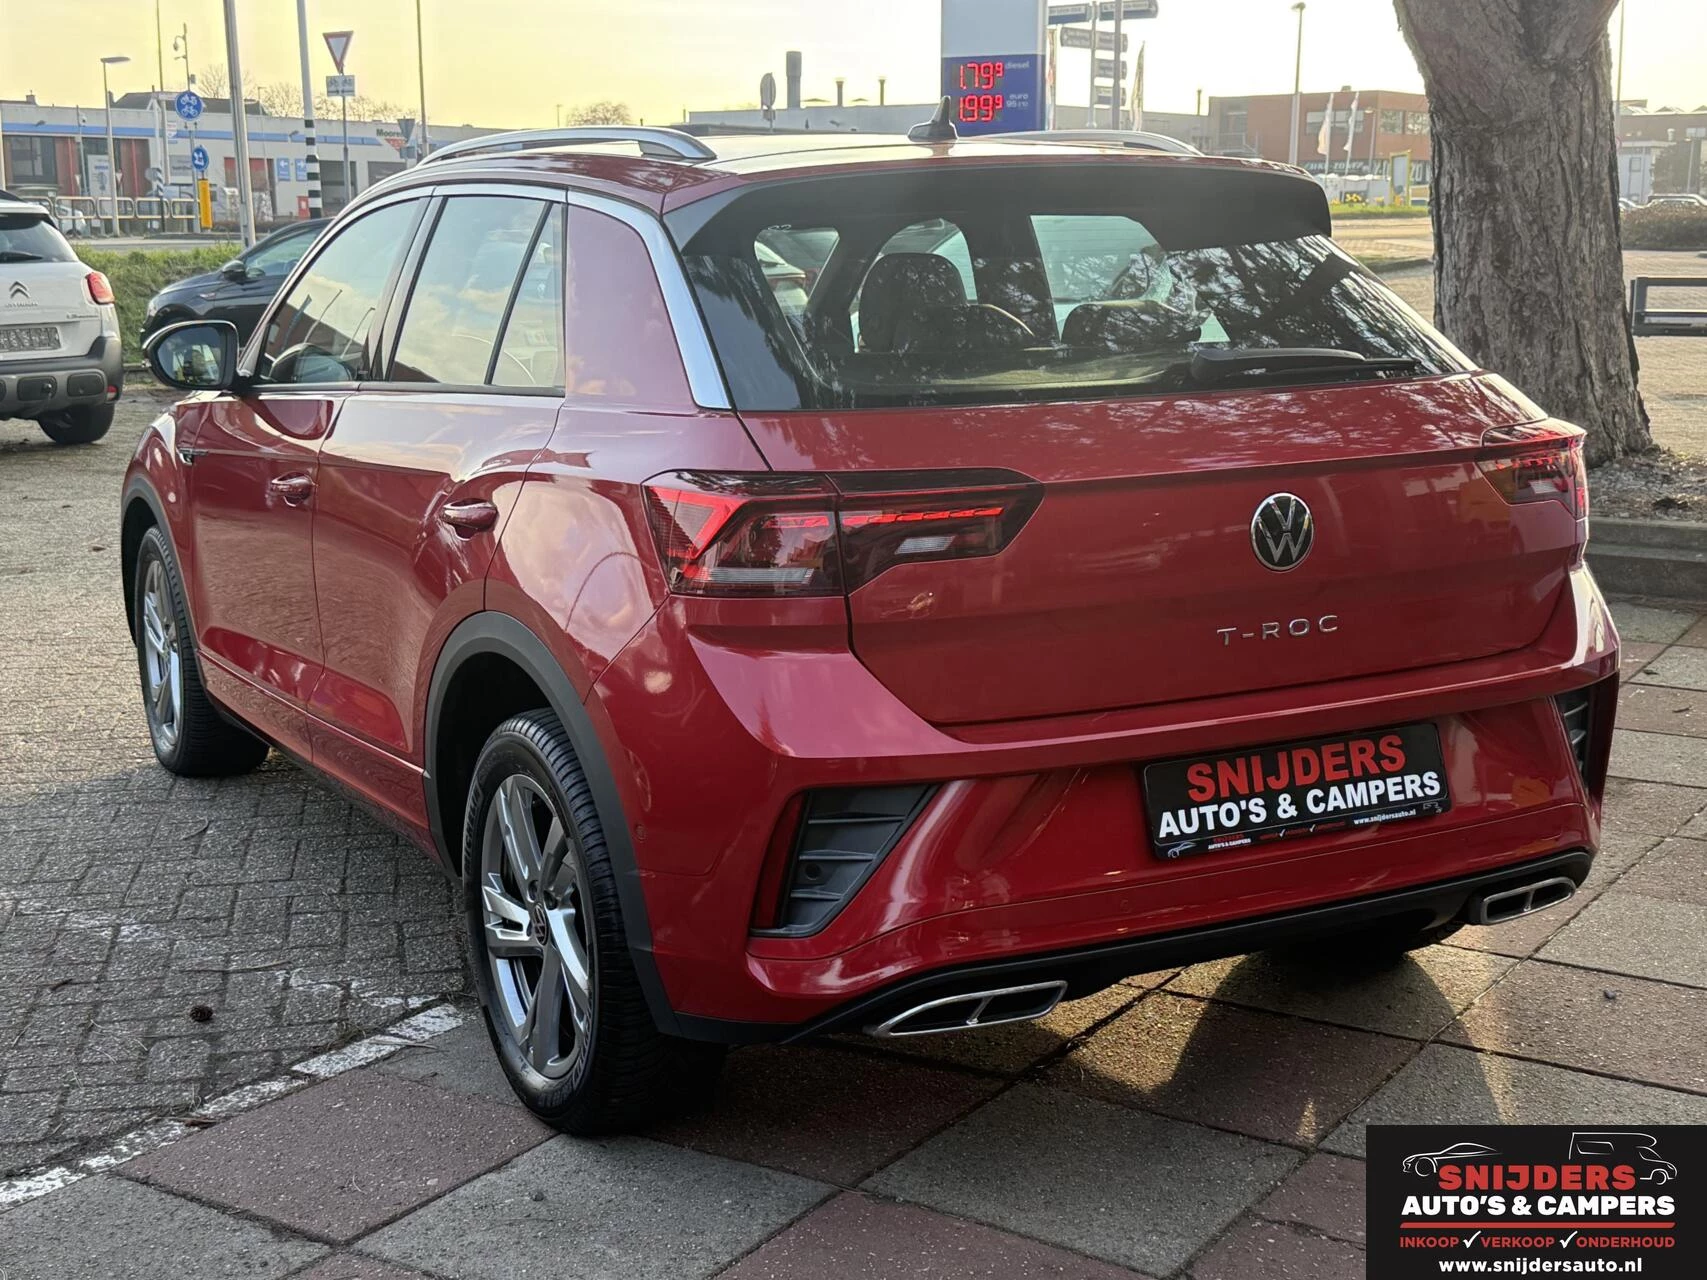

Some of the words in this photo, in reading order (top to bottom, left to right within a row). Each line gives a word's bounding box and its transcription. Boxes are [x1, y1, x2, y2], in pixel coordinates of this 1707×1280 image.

[1217, 615, 1338, 646] T-ROC
[1187, 735, 1407, 802] SNIJDERS
[1159, 797, 1267, 838] AUTO'S
[1277, 793, 1298, 819] &
[1306, 771, 1441, 814] CAMPERS
[1353, 808, 1416, 825] www.snijdersauto.nl
